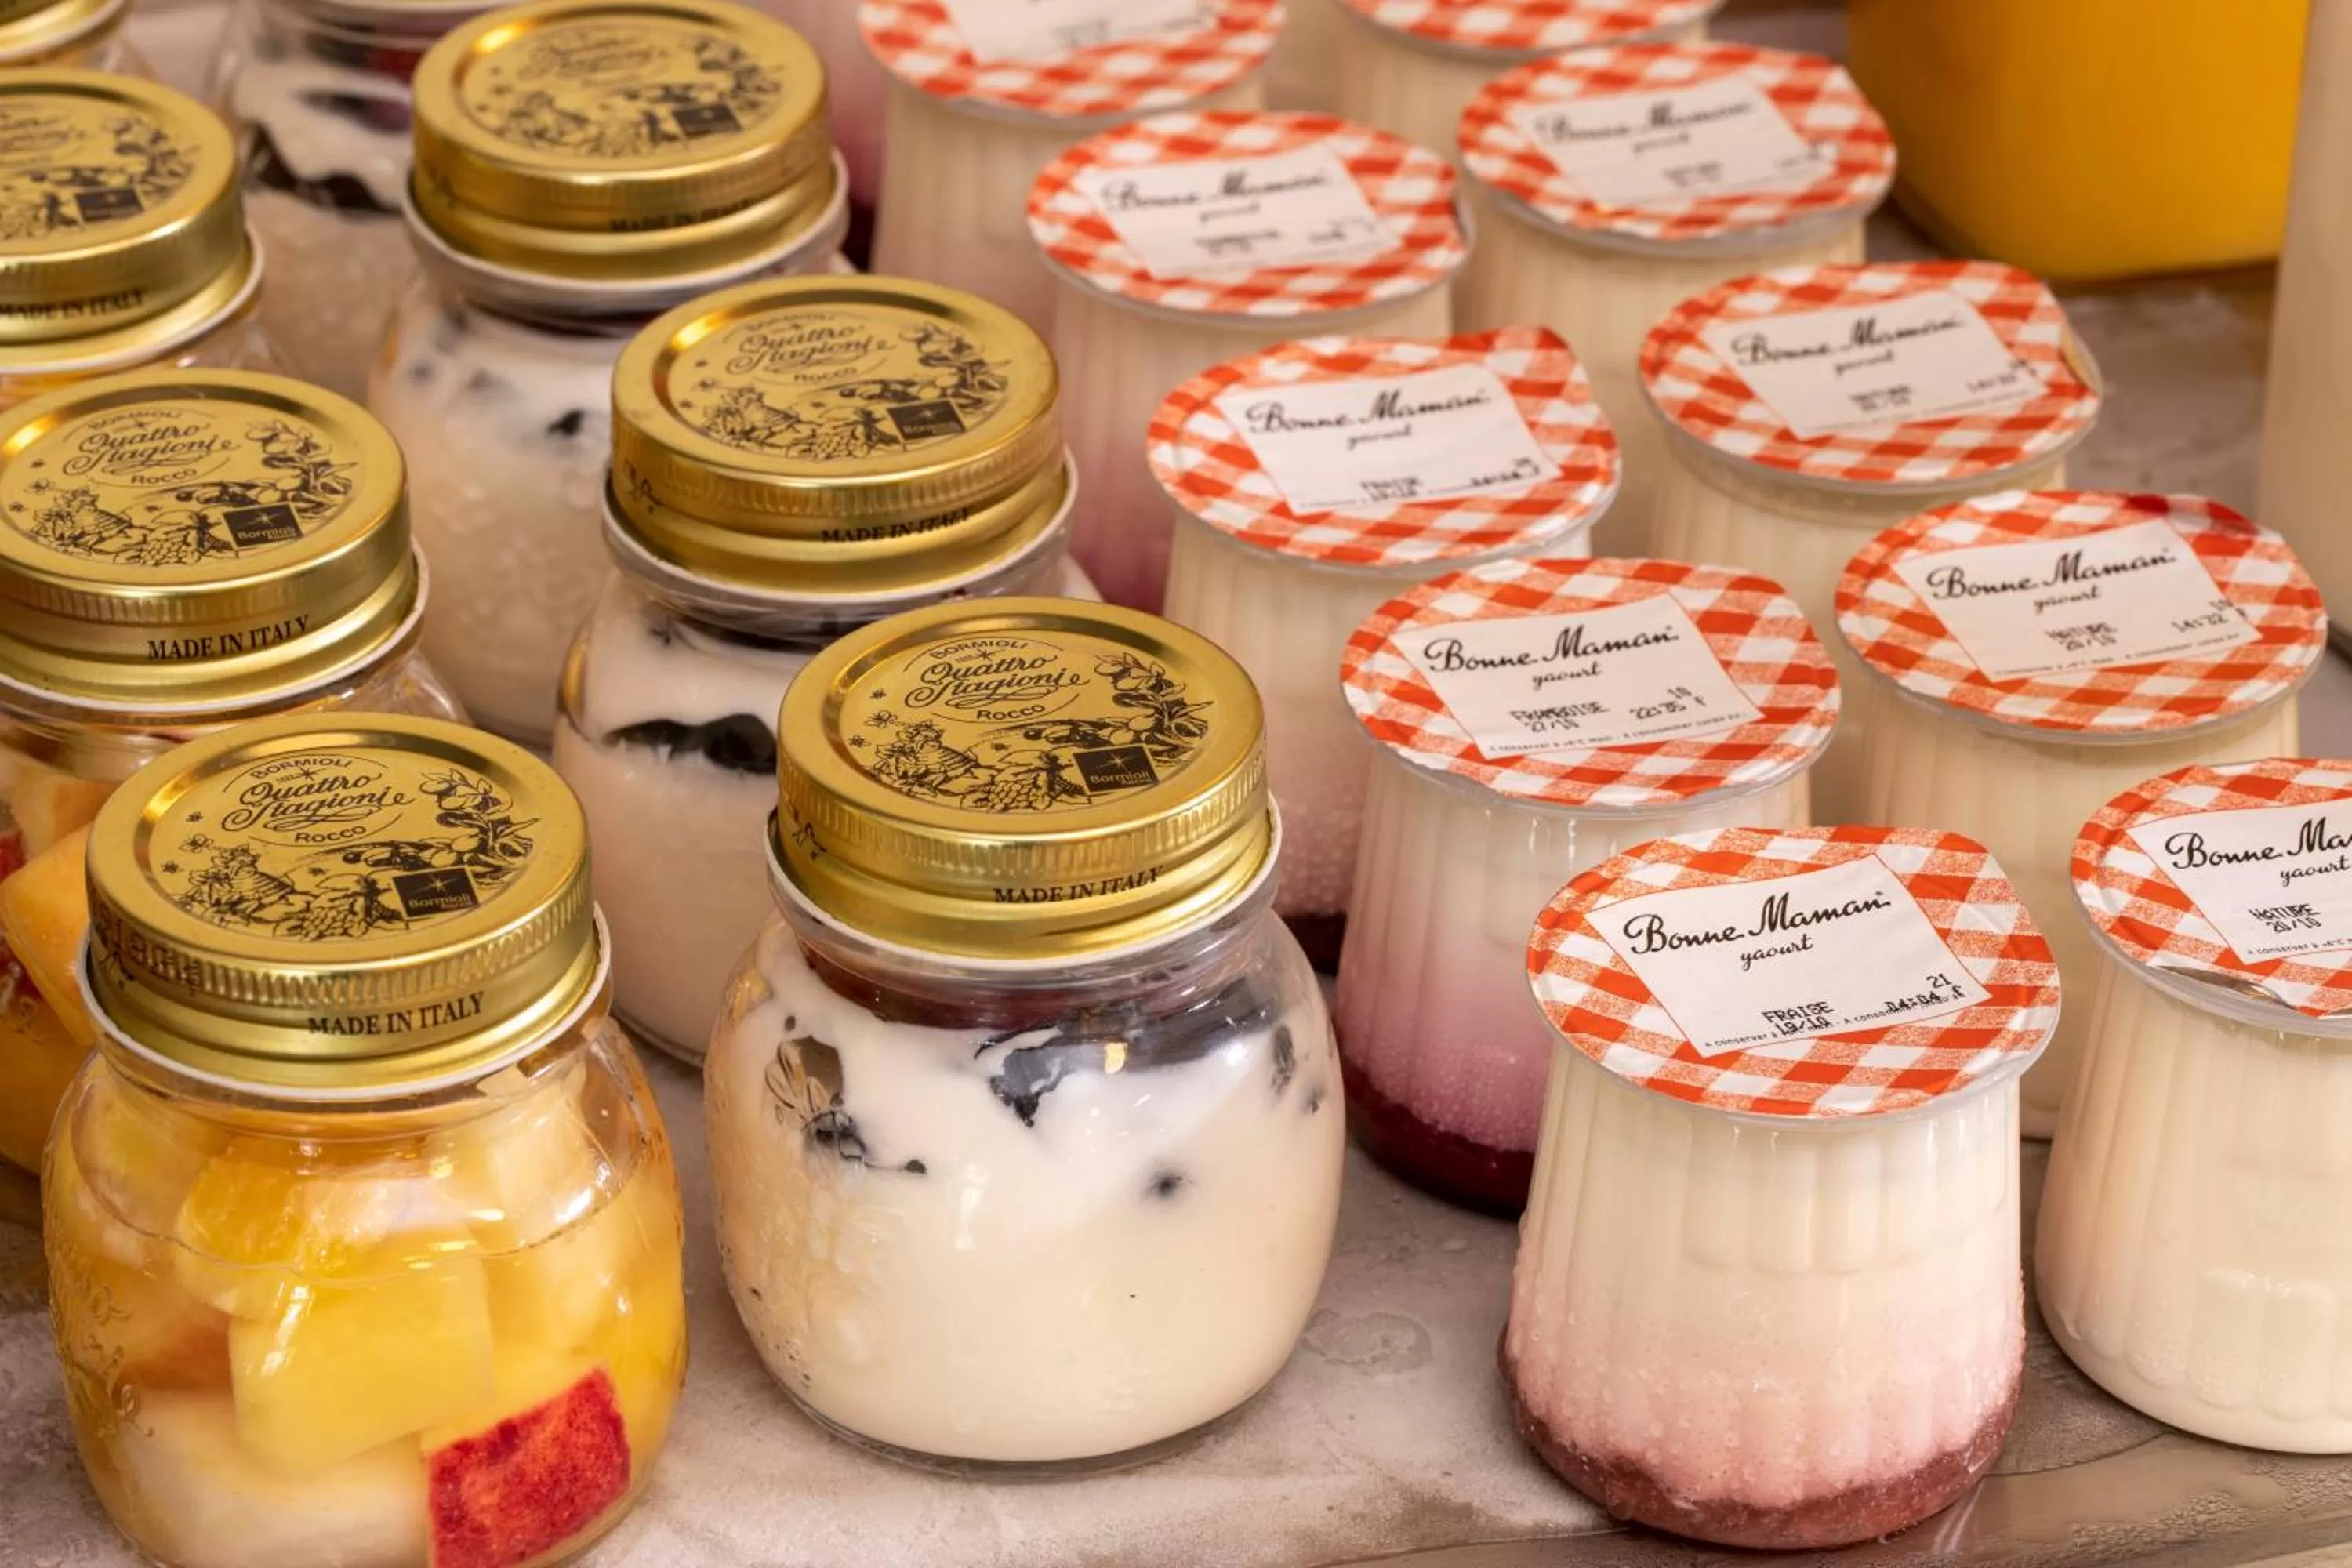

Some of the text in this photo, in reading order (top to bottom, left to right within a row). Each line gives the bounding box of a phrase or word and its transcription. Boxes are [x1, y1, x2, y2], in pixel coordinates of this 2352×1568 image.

[1245, 389, 1493, 434] Bonne Maman
[78, 422, 212, 455] Quattro
[131, 469, 198, 485] ROCCO
[821, 528, 885, 543] MADE
[890, 521, 914, 539] IN
[1926, 549, 2178, 601] Bonne Maman
[147, 614, 310, 660] MADE IN ITALY
[930, 639, 1029, 659] BORMIOLI
[1423, 623, 1680, 673] Bonne Maman
[920, 654, 1058, 686] Quattro
[1532, 661, 1602, 692] yaourt
[976, 704, 1047, 721] ROCCO
[250, 757, 354, 780] BORMIOLI
[238, 771, 383, 808] Quattro
[294, 825, 368, 844] ROCCO
[2164, 832, 2283, 870] Bonne
[993, 865, 1165, 904] MADE IN ITALY
[2279, 854, 2352, 887] yaourt
[1622, 890, 1892, 955] Bonne Maman
[1739, 933, 1815, 972] yaourt
[1925, 972, 1953, 989] 21
[307, 990, 485, 1036] MADE IN ITALY
[1762, 1000, 1835, 1023] FRAISE
